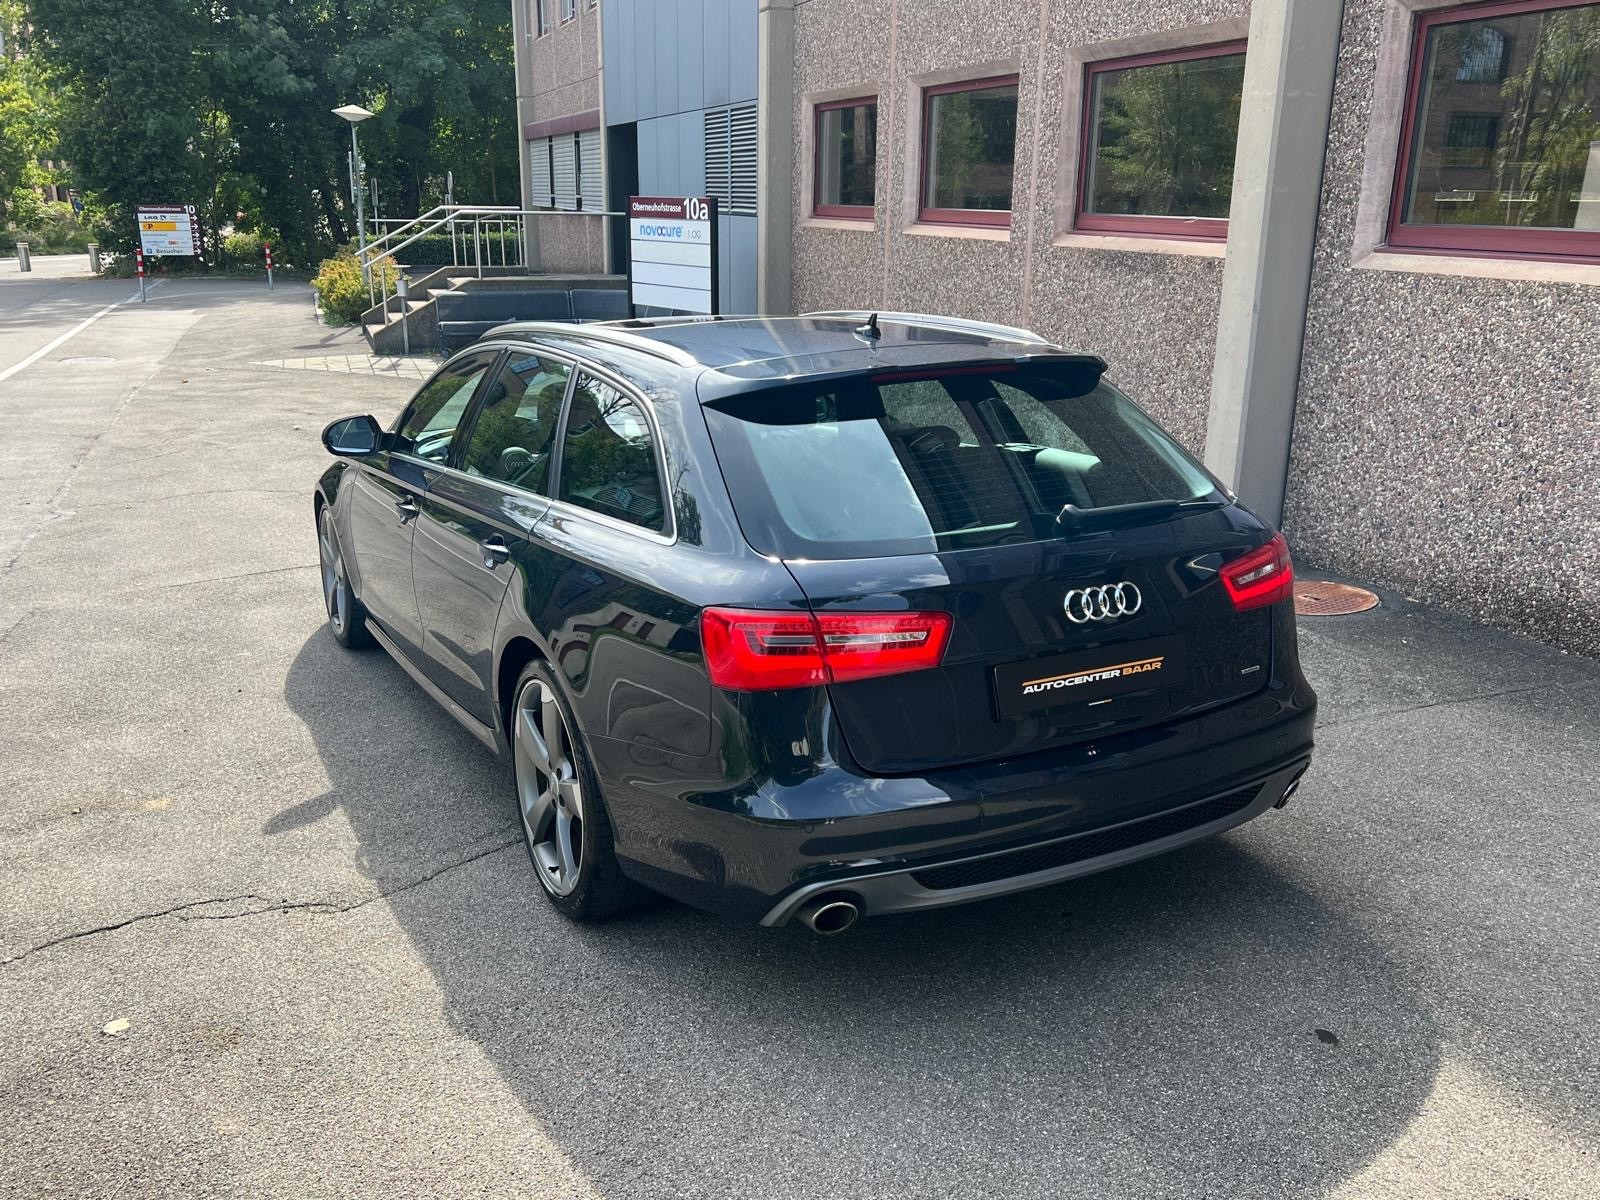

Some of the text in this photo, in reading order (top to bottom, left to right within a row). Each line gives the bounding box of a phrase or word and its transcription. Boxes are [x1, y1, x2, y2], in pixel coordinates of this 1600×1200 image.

[183, 204, 196, 214] 10
[632, 198, 709, 220] Oberneuhofstrasse 10a
[1023, 661, 1162, 695] AUTOCENTER BAAR
